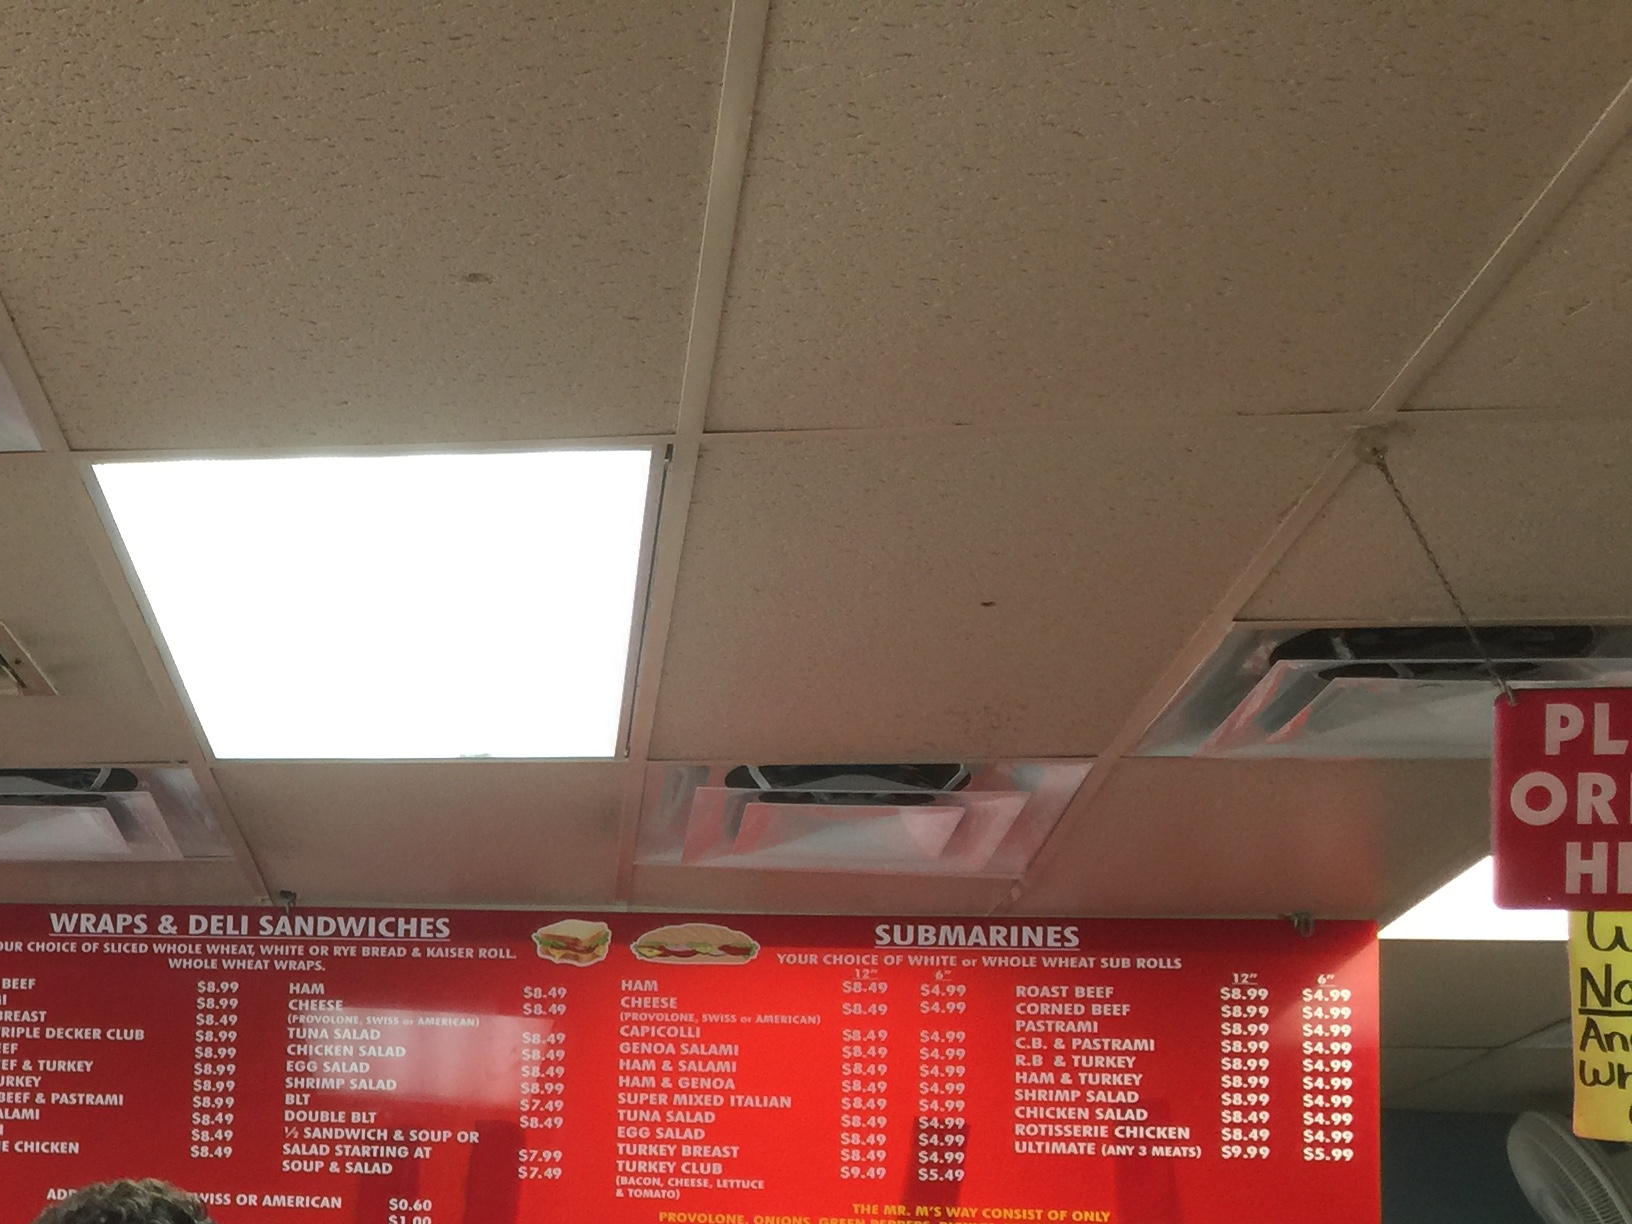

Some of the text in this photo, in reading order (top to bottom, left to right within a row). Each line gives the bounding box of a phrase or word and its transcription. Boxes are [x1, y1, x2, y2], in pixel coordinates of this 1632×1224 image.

[1510, 771, 1632, 826] OR
[50, 913, 449, 938] WRAPS & DELI SANDWICHES
[875, 924, 1078, 948] SUBMARINES
[777, 953, 817, 964] YOUR
[823, 954, 877, 964] CHOICE
[884, 955, 902, 965] OF
[908, 955, 956, 965] WHITE
[982, 956, 1036, 967] WHOLE
[1042, 956, 1095, 967] WHEAT
[1100, 957, 1130, 968] SUB
[1136, 957, 1181, 968] ROLLS
[2, 978, 35, 989] BEEF
[198, 981, 238, 992] $8.99
[289, 982, 566, 998] HAM $8.49
[197, 997, 238, 1008] $8.99
[1016, 1002, 1351, 1019] CORNED BEEF $8.99 $4.99
[45, 1027, 101, 1039] DECKER
[106, 1028, 144, 1040] CLUB
[196, 1030, 236, 1042] $8.99
[620, 1025, 965, 1042] CAPICOLLI $8.49 $4.99
[1580, 1017, 1632, 1053] An
[285, 1077, 564, 1094] SHRIMP SALAD $8.99
[618, 1092, 790, 1107] SUPER MIXED ITALIAN
[1015, 1141, 1353, 1160] ULTIMATE (ANY 3 MEATS) $9.99 $5.99
